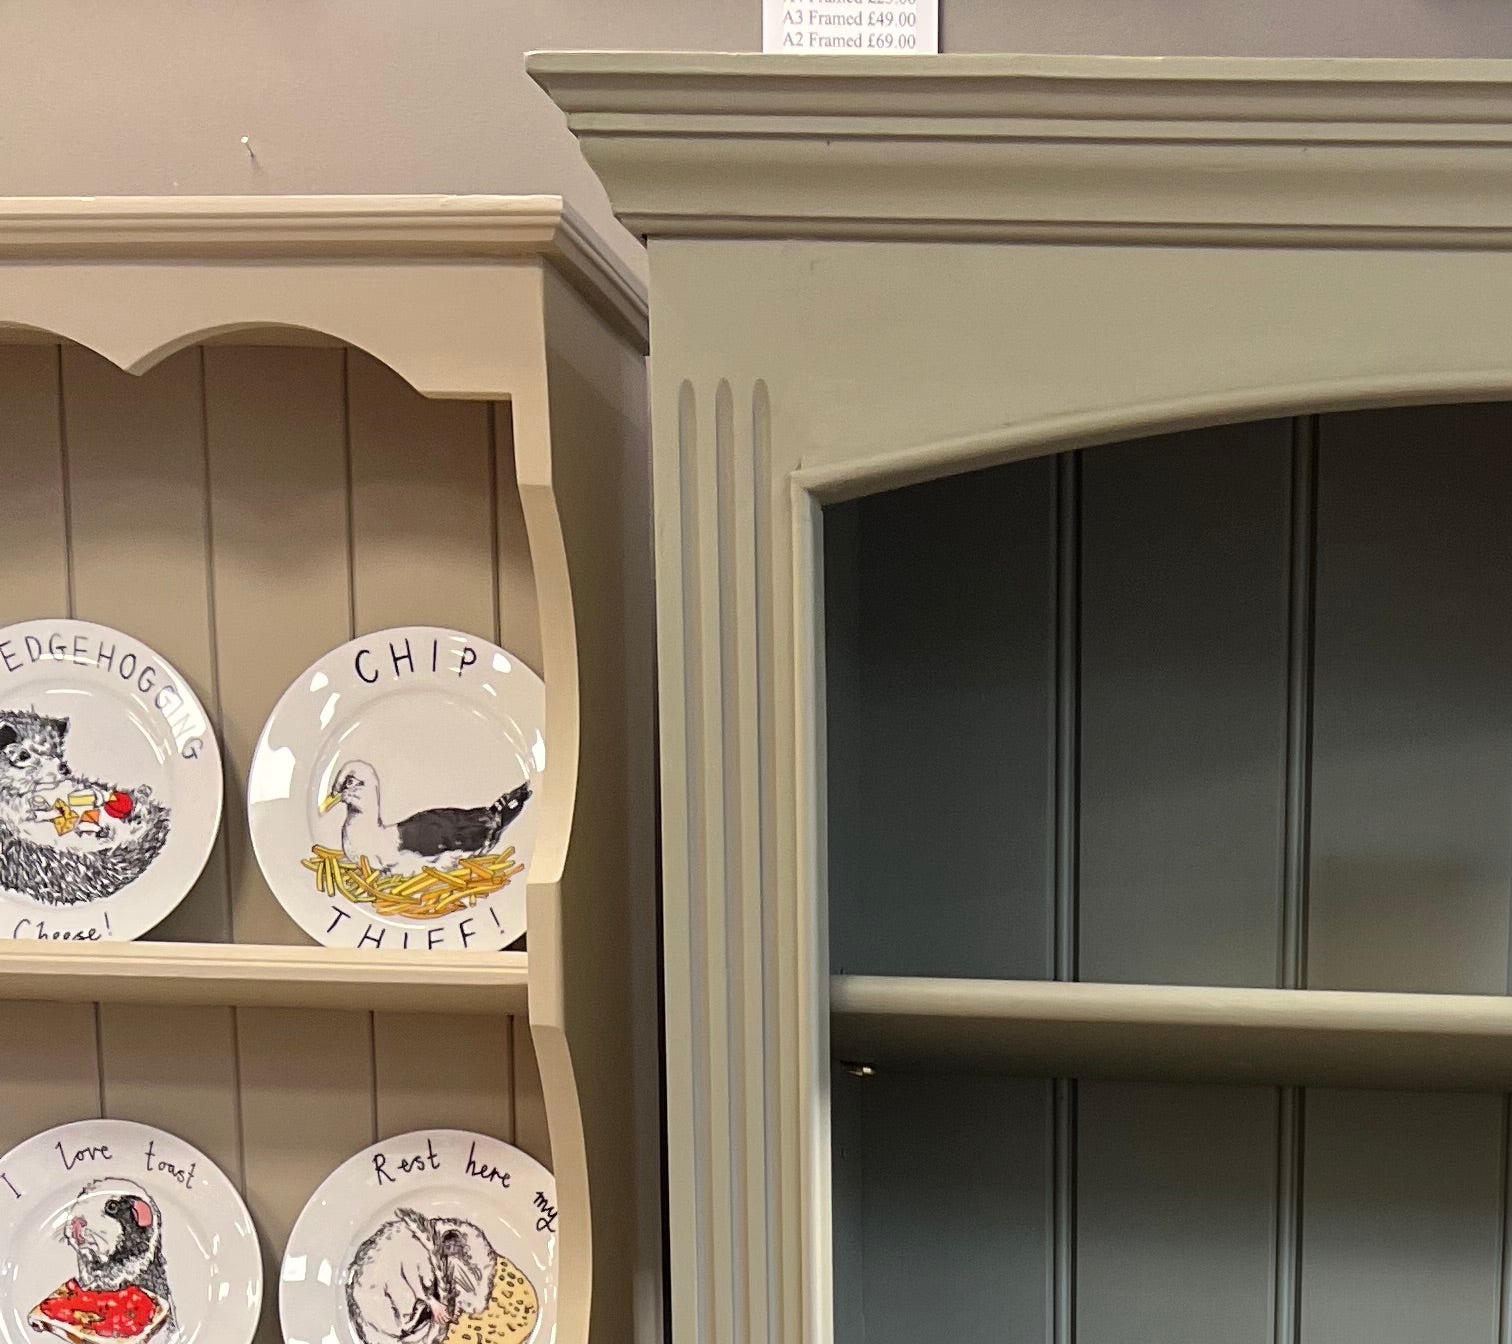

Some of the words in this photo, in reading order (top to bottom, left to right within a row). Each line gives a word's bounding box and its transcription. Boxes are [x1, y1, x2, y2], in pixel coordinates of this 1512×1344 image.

[783, 10, 804, 25] A3
[809, 10, 863, 26] Framed
[867, 11, 917, 27] £49.00
[783, 31, 804, 47] A2
[809, 31, 863, 48] Framed
[867, 33, 917, 49] £69.00
[354, 637, 478, 684] CHIP
[0, 632, 204, 761] EDGEHOGGING
[0, 1172, 22, 1199] I
[144, 1140, 198, 1190] toast
[372, 1137, 441, 1186] Rest
[464, 1140, 512, 1188] here
